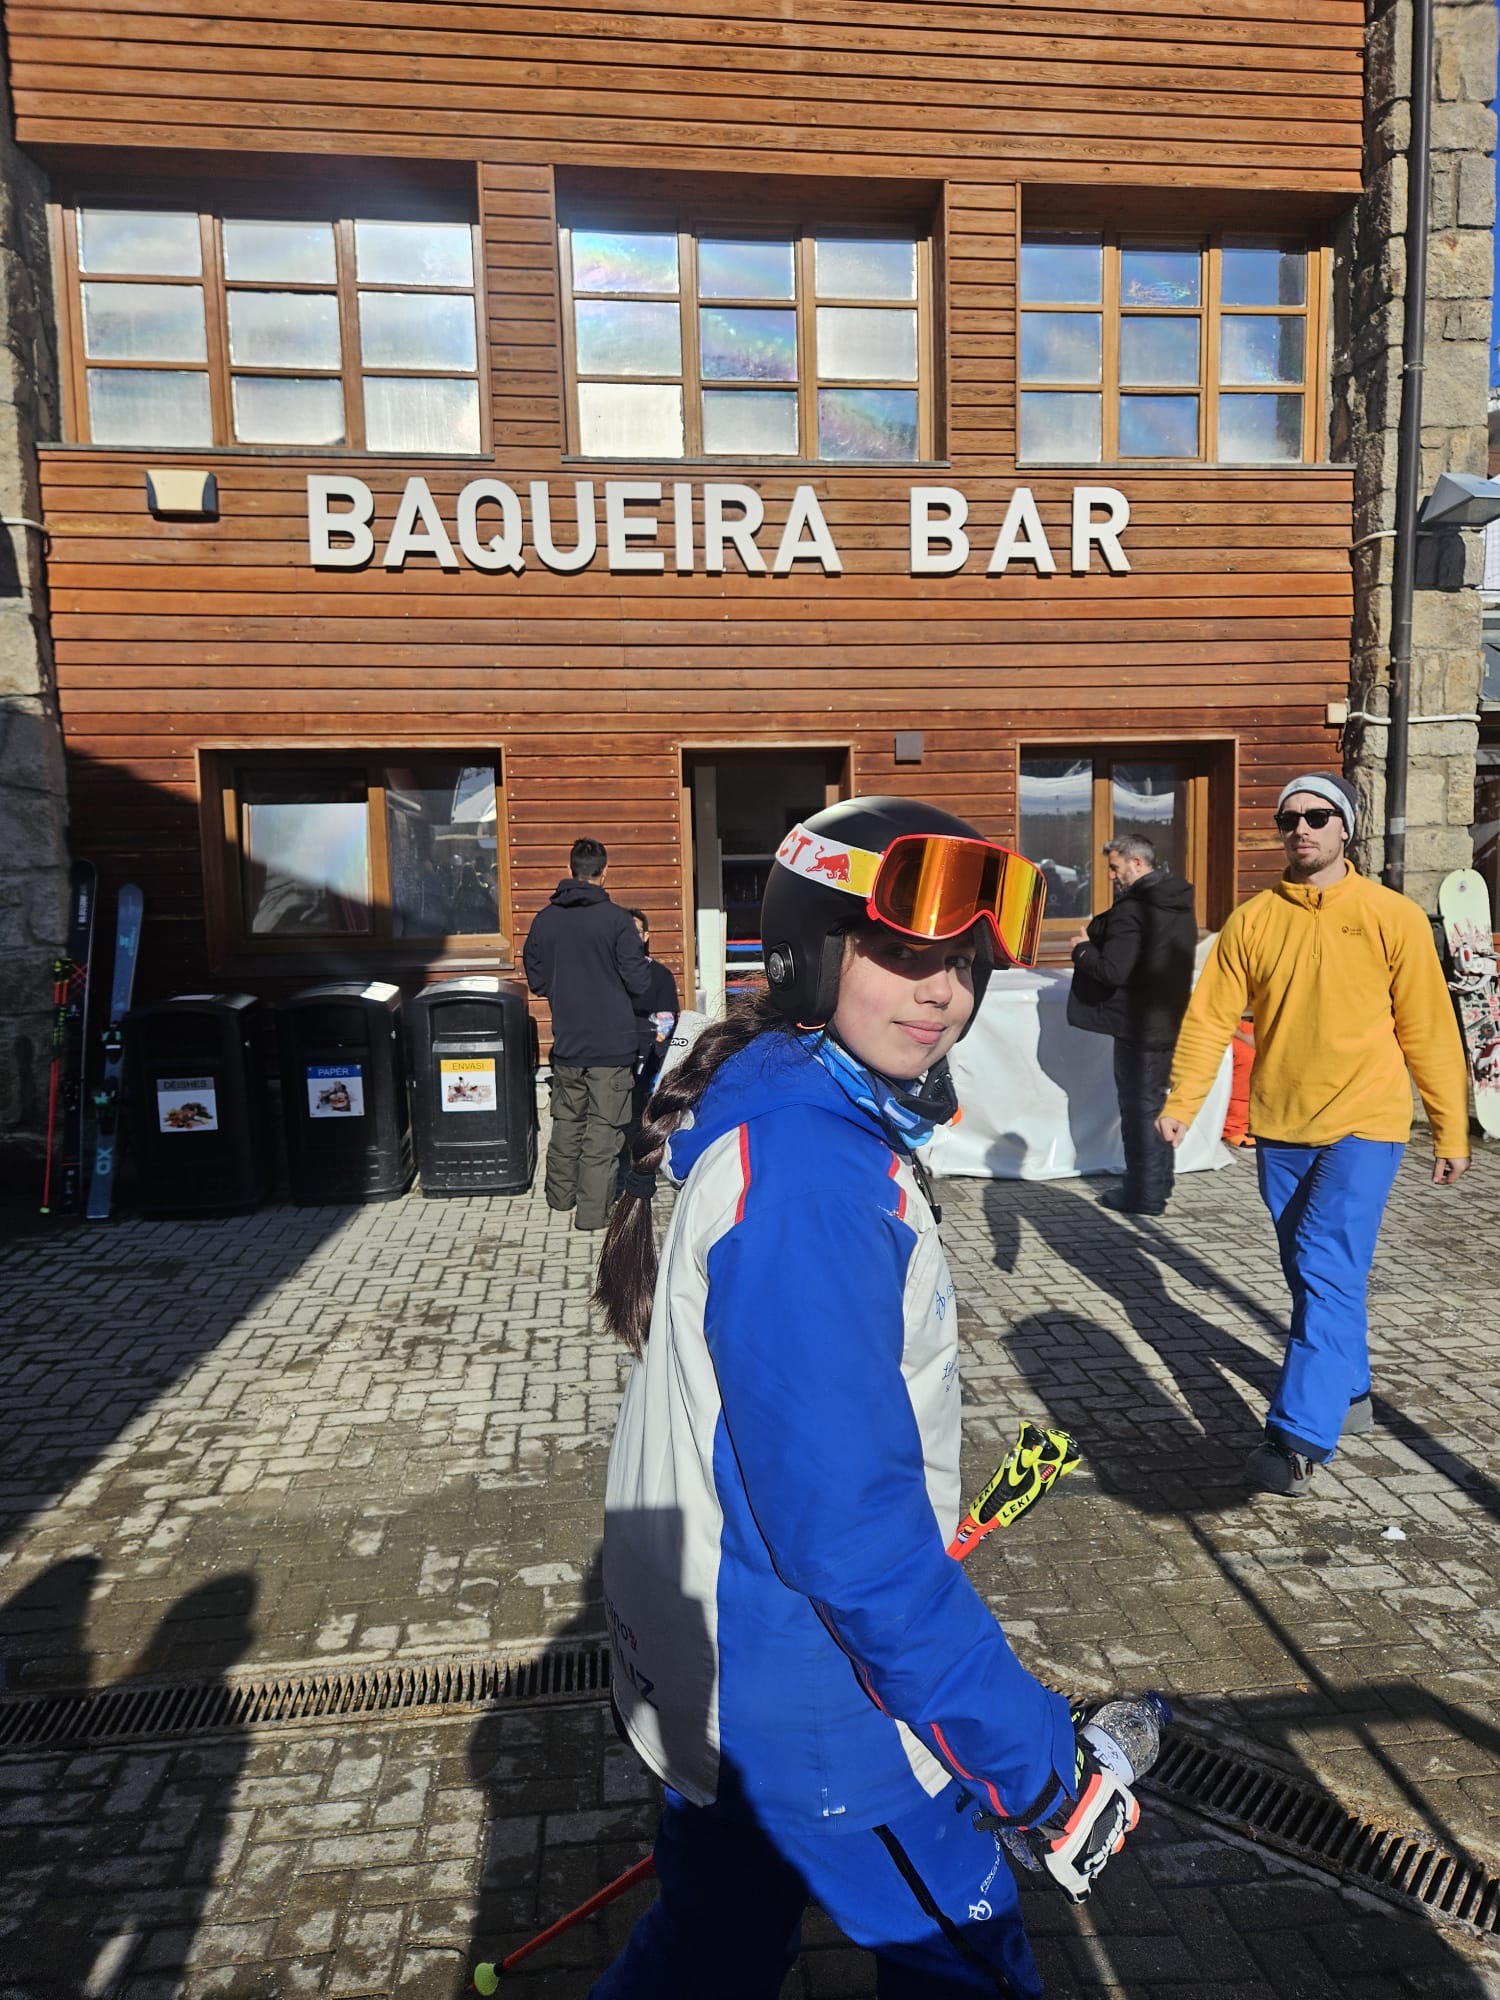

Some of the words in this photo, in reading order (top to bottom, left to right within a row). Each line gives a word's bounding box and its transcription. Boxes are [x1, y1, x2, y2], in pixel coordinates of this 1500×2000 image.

[307, 475, 843, 576] BAQUEIRA
[910, 486, 1131, 573] BAR
[1002, 1494, 1031, 1519] LEKI
